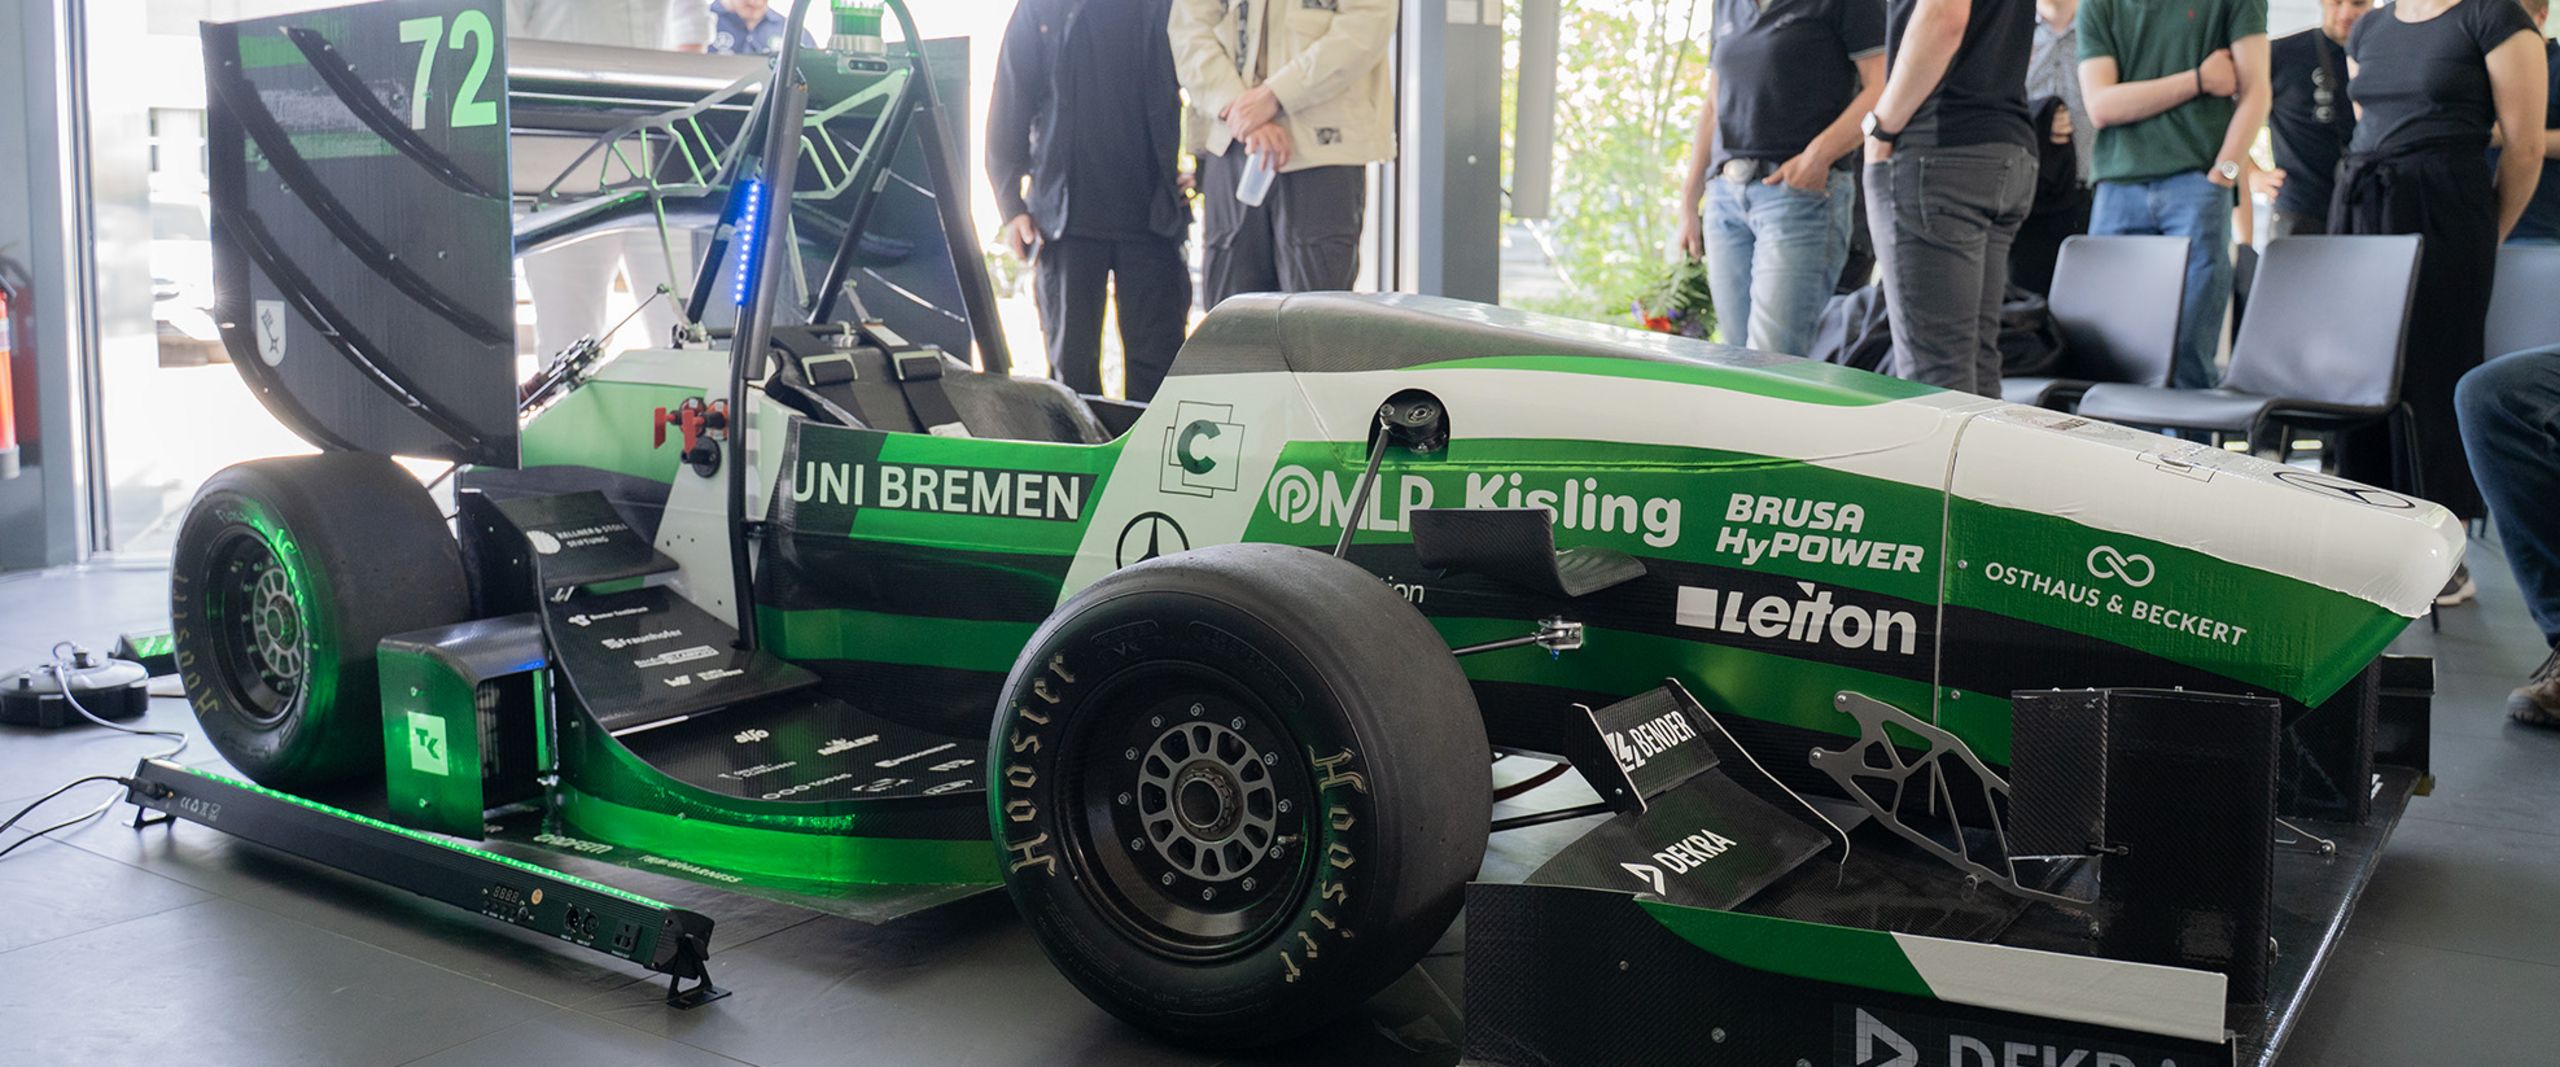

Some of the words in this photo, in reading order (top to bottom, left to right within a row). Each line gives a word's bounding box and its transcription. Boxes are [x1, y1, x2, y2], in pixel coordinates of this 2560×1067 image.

[399, 9, 498, 131] 72
[791, 461, 865, 505] UNI
[879, 465, 1080, 520] BREMEN
[1464, 471, 1682, 548] Kisling
[1724, 493, 1866, 534] BRUSA
[1715, 526, 1925, 574] HyPOWER
[1984, 561, 2102, 608] OSTHAUS
[2105, 594, 2124, 616] &
[2131, 600, 2248, 647] BECKERT
[1000, 654, 1076, 877] Hoosier
[1628, 710, 1697, 759] BENDER
[1279, 744, 1368, 984] Hoosier
[1652, 828, 1738, 875] DEKRA
